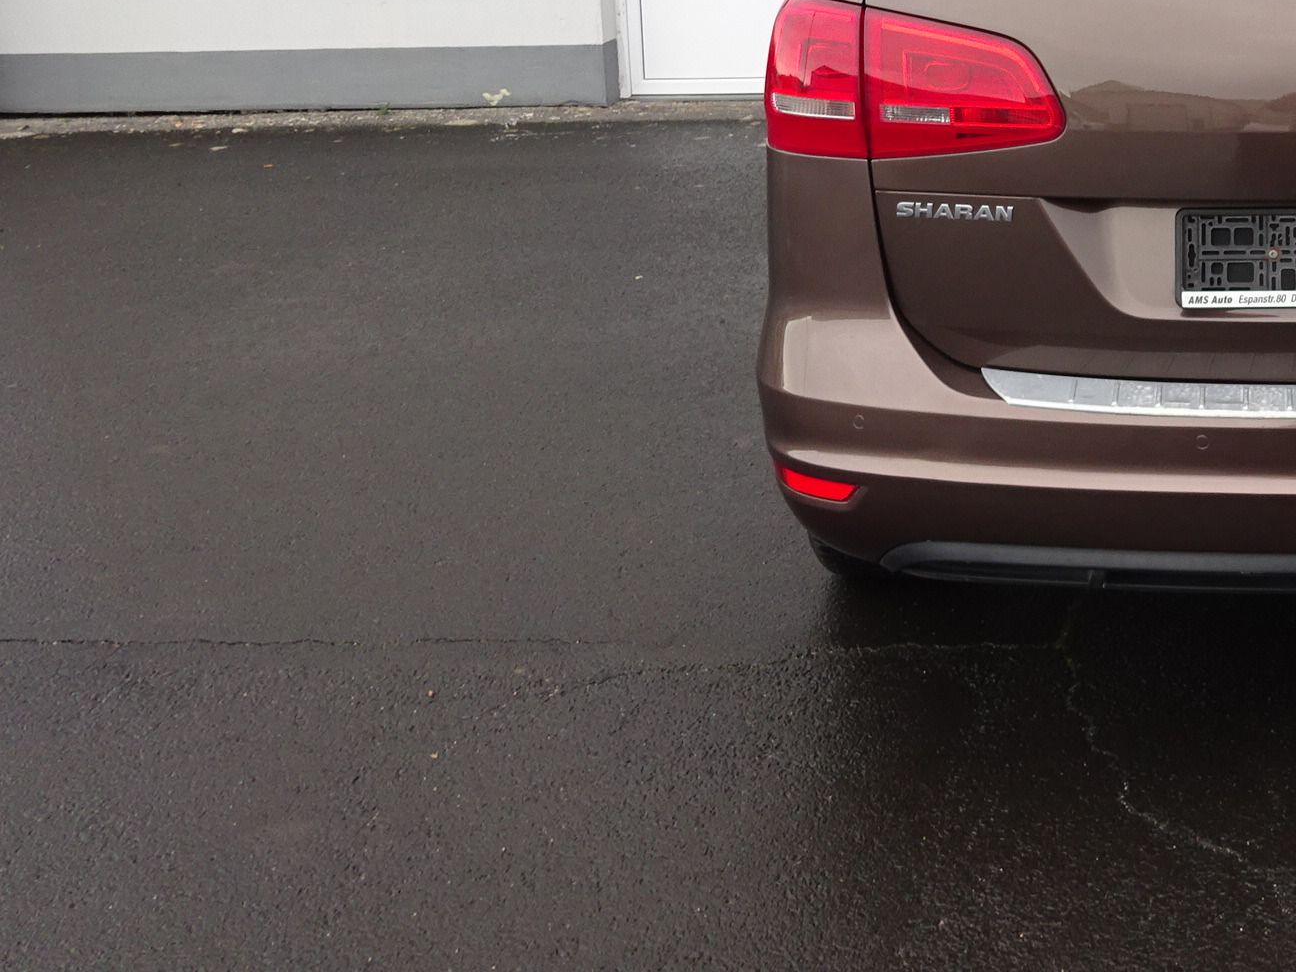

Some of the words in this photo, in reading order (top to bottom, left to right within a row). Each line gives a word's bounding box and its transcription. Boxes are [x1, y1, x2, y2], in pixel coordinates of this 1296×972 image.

[896, 201, 1014, 222] SHARAN
[1188, 295, 1209, 305] AMS
[1211, 295, 1233, 305] Auto
[1238, 294, 1287, 305] Espanstr.80
